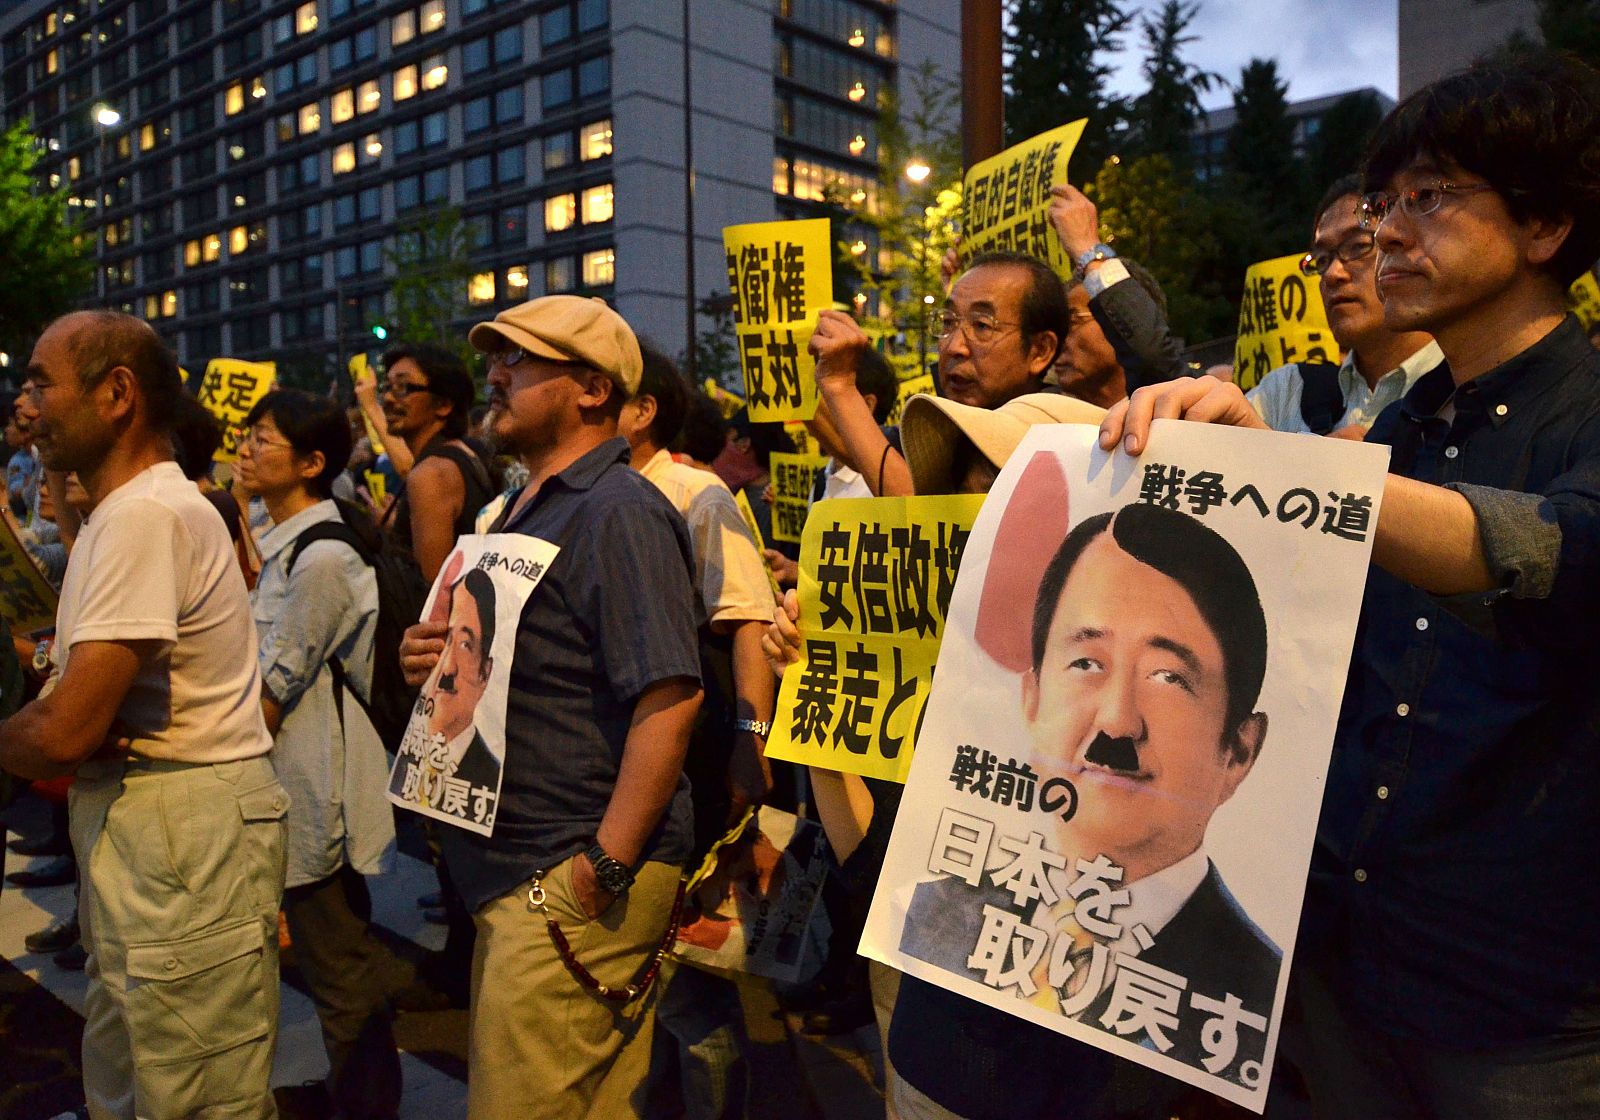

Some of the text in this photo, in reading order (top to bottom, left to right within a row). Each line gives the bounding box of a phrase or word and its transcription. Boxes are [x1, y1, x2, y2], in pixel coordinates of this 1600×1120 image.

[1138, 463, 1372, 543] 戦争への道
[791, 639, 935, 759] 暴走と
[949, 744, 1079, 822] 戦前の
[967, 903, 1266, 1091] 取り戻す。
